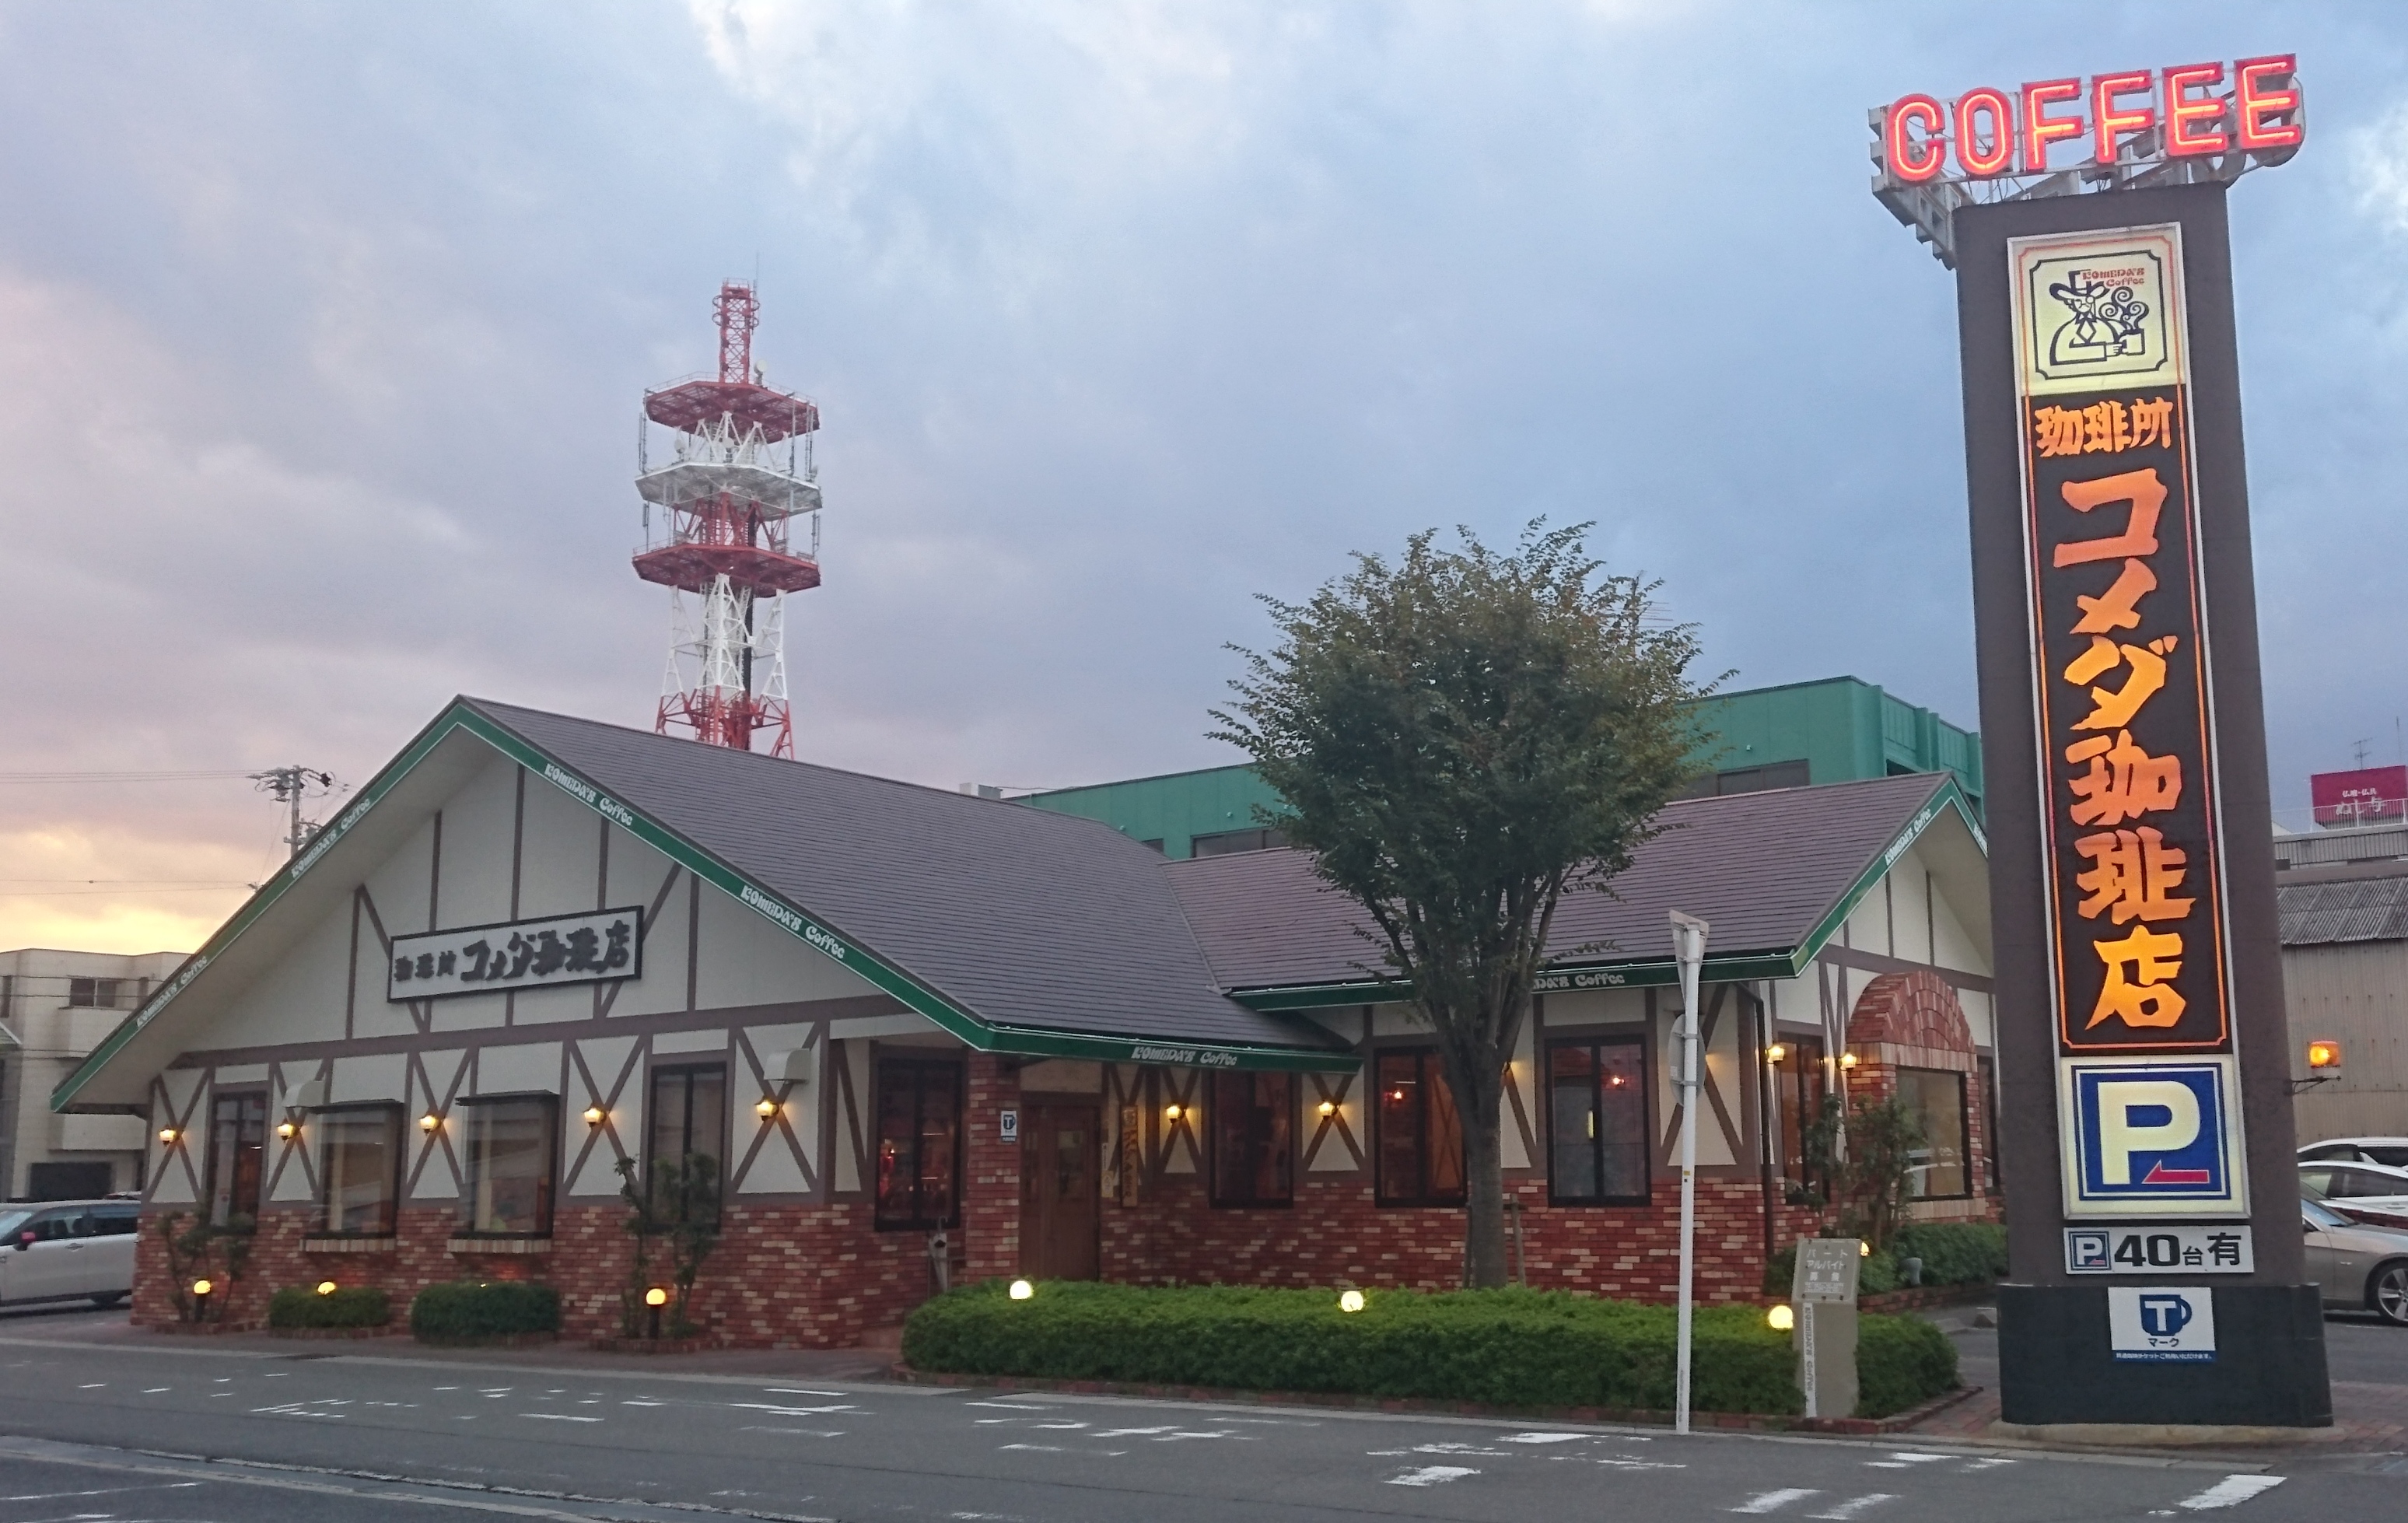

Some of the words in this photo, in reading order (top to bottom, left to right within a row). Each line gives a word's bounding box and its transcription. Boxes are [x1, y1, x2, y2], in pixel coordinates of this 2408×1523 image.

[1887, 53, 2302, 181] COFFEE
[2105, 278, 2145, 287] Coffee
[2034, 396, 2174, 457] 珈琲所
[2053, 467, 2196, 1031] コメダ珈琲店
[340, 799, 370, 830] Coffee
[600, 797, 633, 826] Coffee
[805, 926, 845, 959] Coffee
[1574, 972, 1625, 987] Coffee
[1200, 1052, 1237, 1066] Coffee
[2097, 1080, 2200, 1185] P
[1806, 1260, 1844, 1269] アルバイト
[2075, 1237, 2103, 1266] P
[2144, 1301, 2176, 1332] T
[2147, 1338, 2179, 1347] マーク
